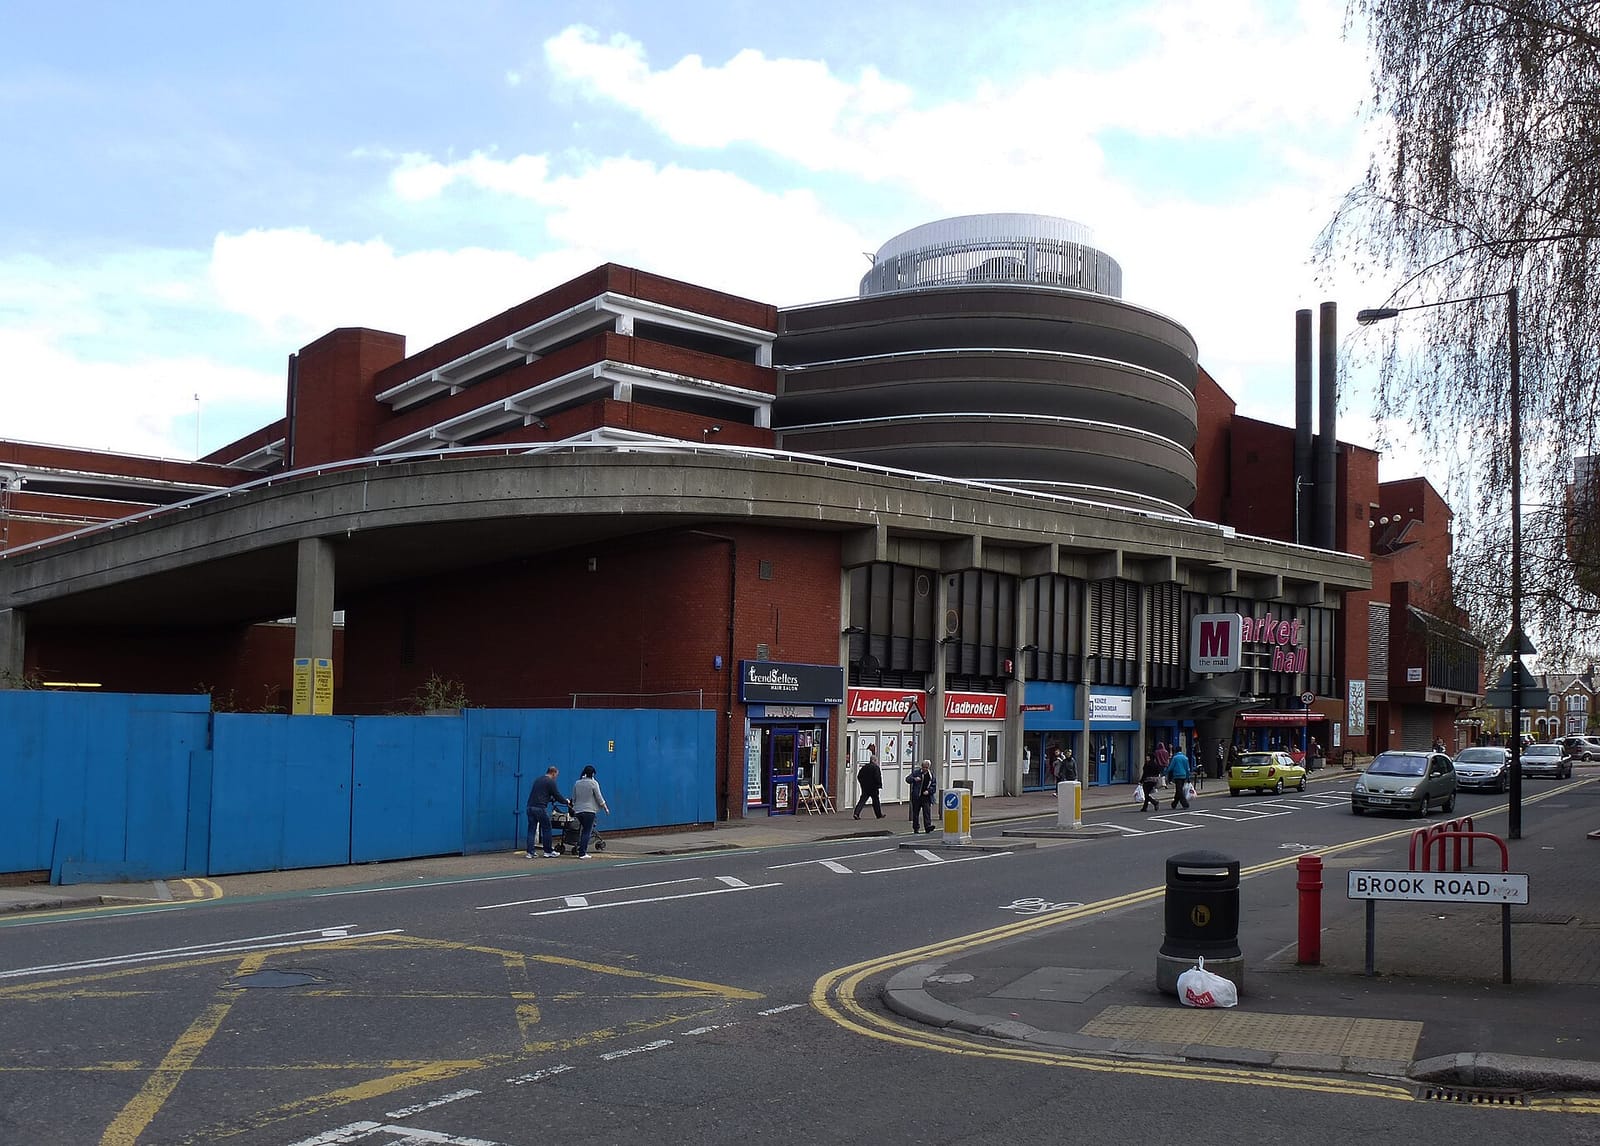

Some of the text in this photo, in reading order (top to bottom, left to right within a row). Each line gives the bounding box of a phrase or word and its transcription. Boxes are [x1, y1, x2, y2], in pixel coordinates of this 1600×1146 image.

[1200, 621, 1231, 658] M
[1199, 658, 1229, 666] the mall
[1272, 646, 1307, 673] hall
[1302, 694, 1313, 702] 20
[856, 698, 910, 713] Ladbrokes
[950, 701, 993, 715] Ladbrokes
[1357, 877, 1425, 894] BROOK
[1434, 879, 1490, 896] ROAD
[1187, 990, 1210, 1004] Iceand
